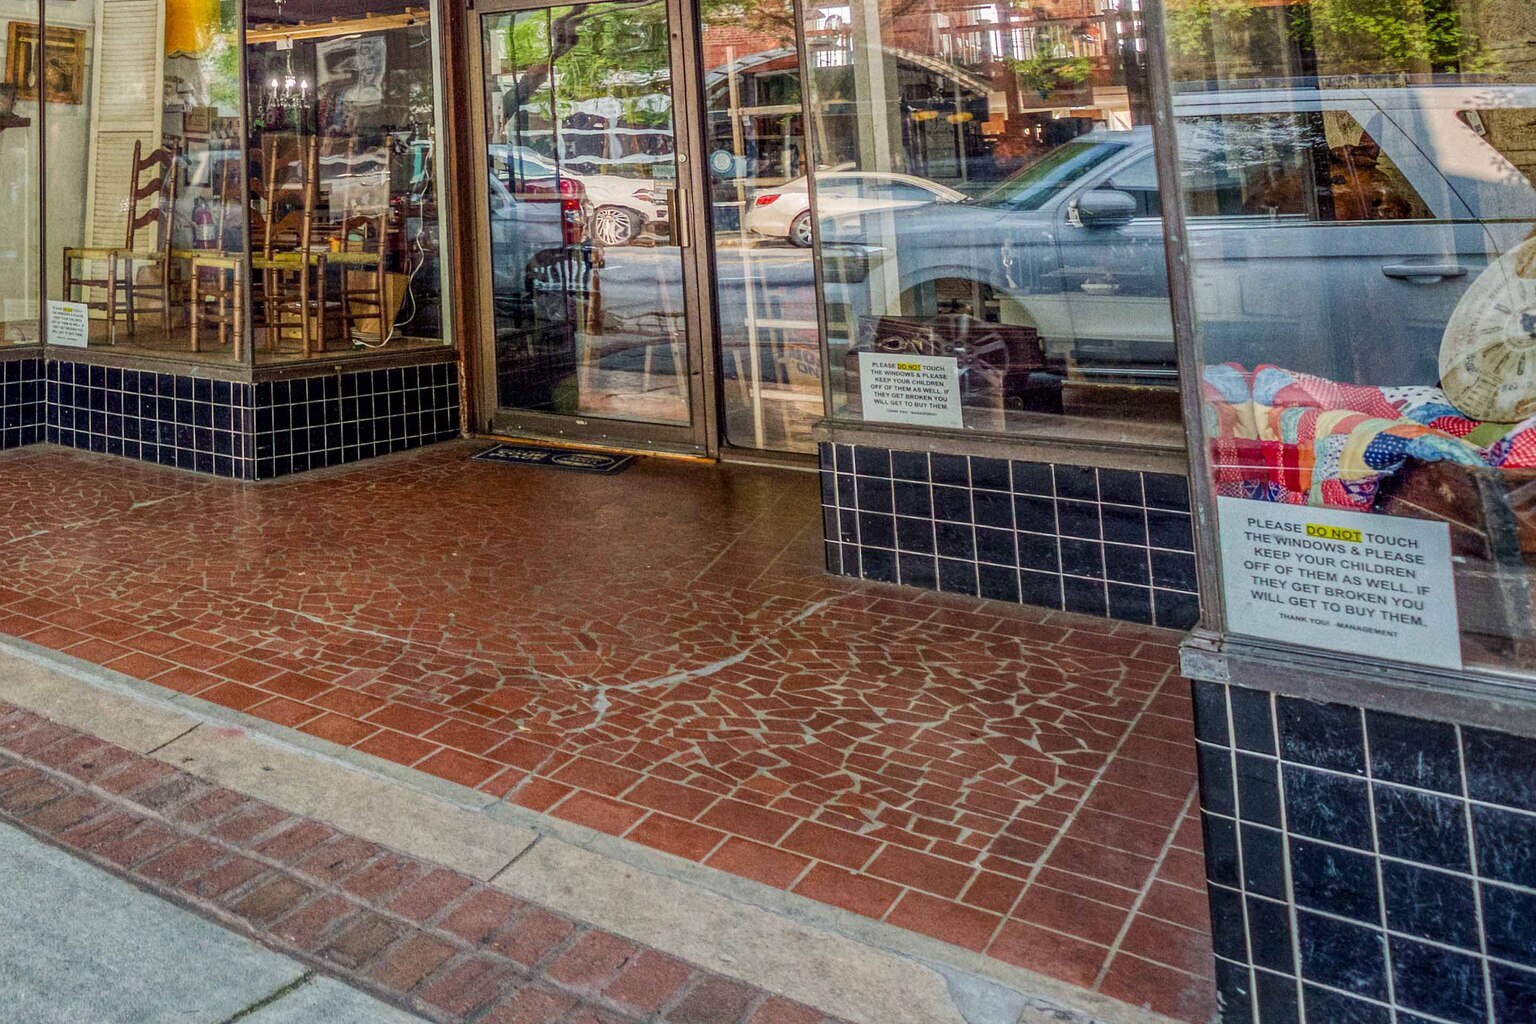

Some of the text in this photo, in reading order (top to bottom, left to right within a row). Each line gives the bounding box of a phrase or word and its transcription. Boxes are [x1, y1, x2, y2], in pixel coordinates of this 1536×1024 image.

[884, 370, 915, 378] WINDOWS
[912, 379, 944, 387] CHILDREN
[1244, 531, 1425, 565] THE WINDOWS & PLEASE
[1247, 517, 1418, 549] PLEASE DO NOT TOUCH
[1243, 560, 1430, 596] OFF OF THEM AS WELL. IF
[1254, 547, 1416, 579] KEEP YOUR CHILDREN
[1250, 590, 1428, 627] WILL GET TO BUY THEM.
[1251, 576, 1424, 611] THEY GET BROKEN YOU
[1279, 612, 1307, 623] THANK
